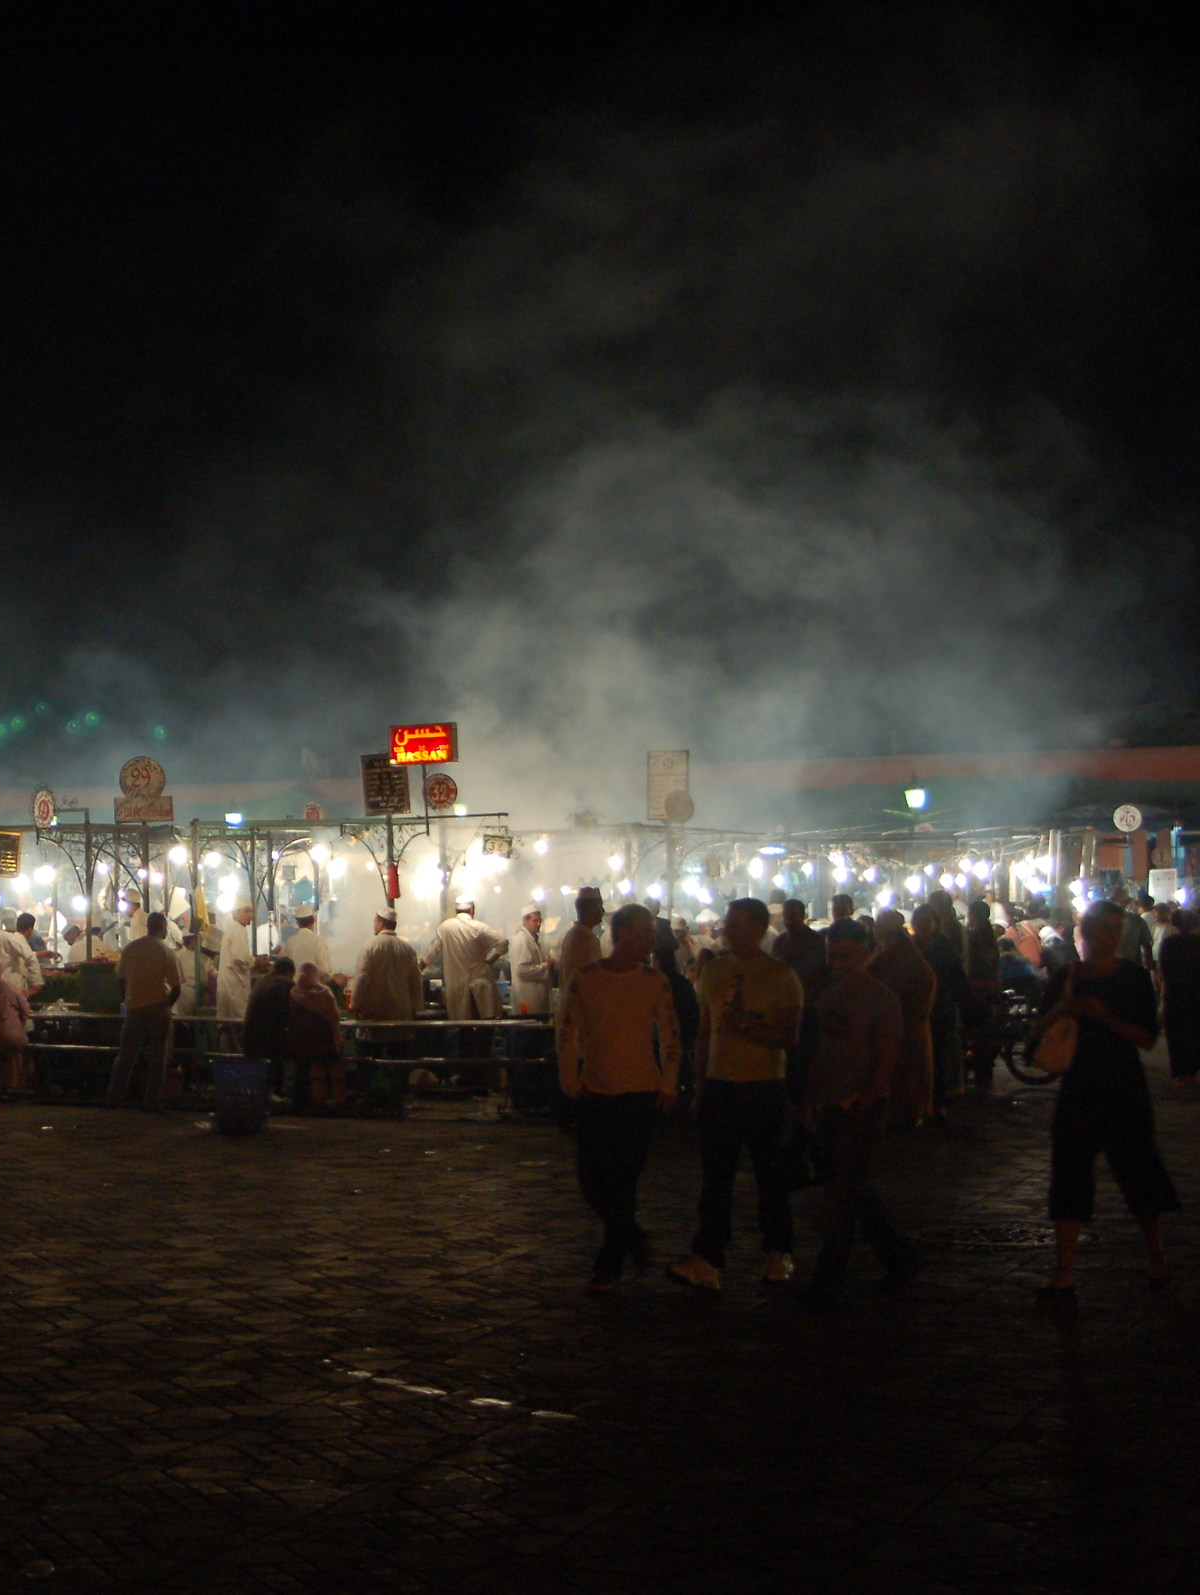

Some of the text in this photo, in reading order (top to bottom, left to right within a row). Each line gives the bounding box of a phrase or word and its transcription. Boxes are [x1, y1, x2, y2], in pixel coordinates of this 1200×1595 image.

[395, 725, 446, 746] حسن
[396, 750, 448, 762] HASSAN
[131, 767, 151, 787] 29
[431, 783, 447, 800] 32
